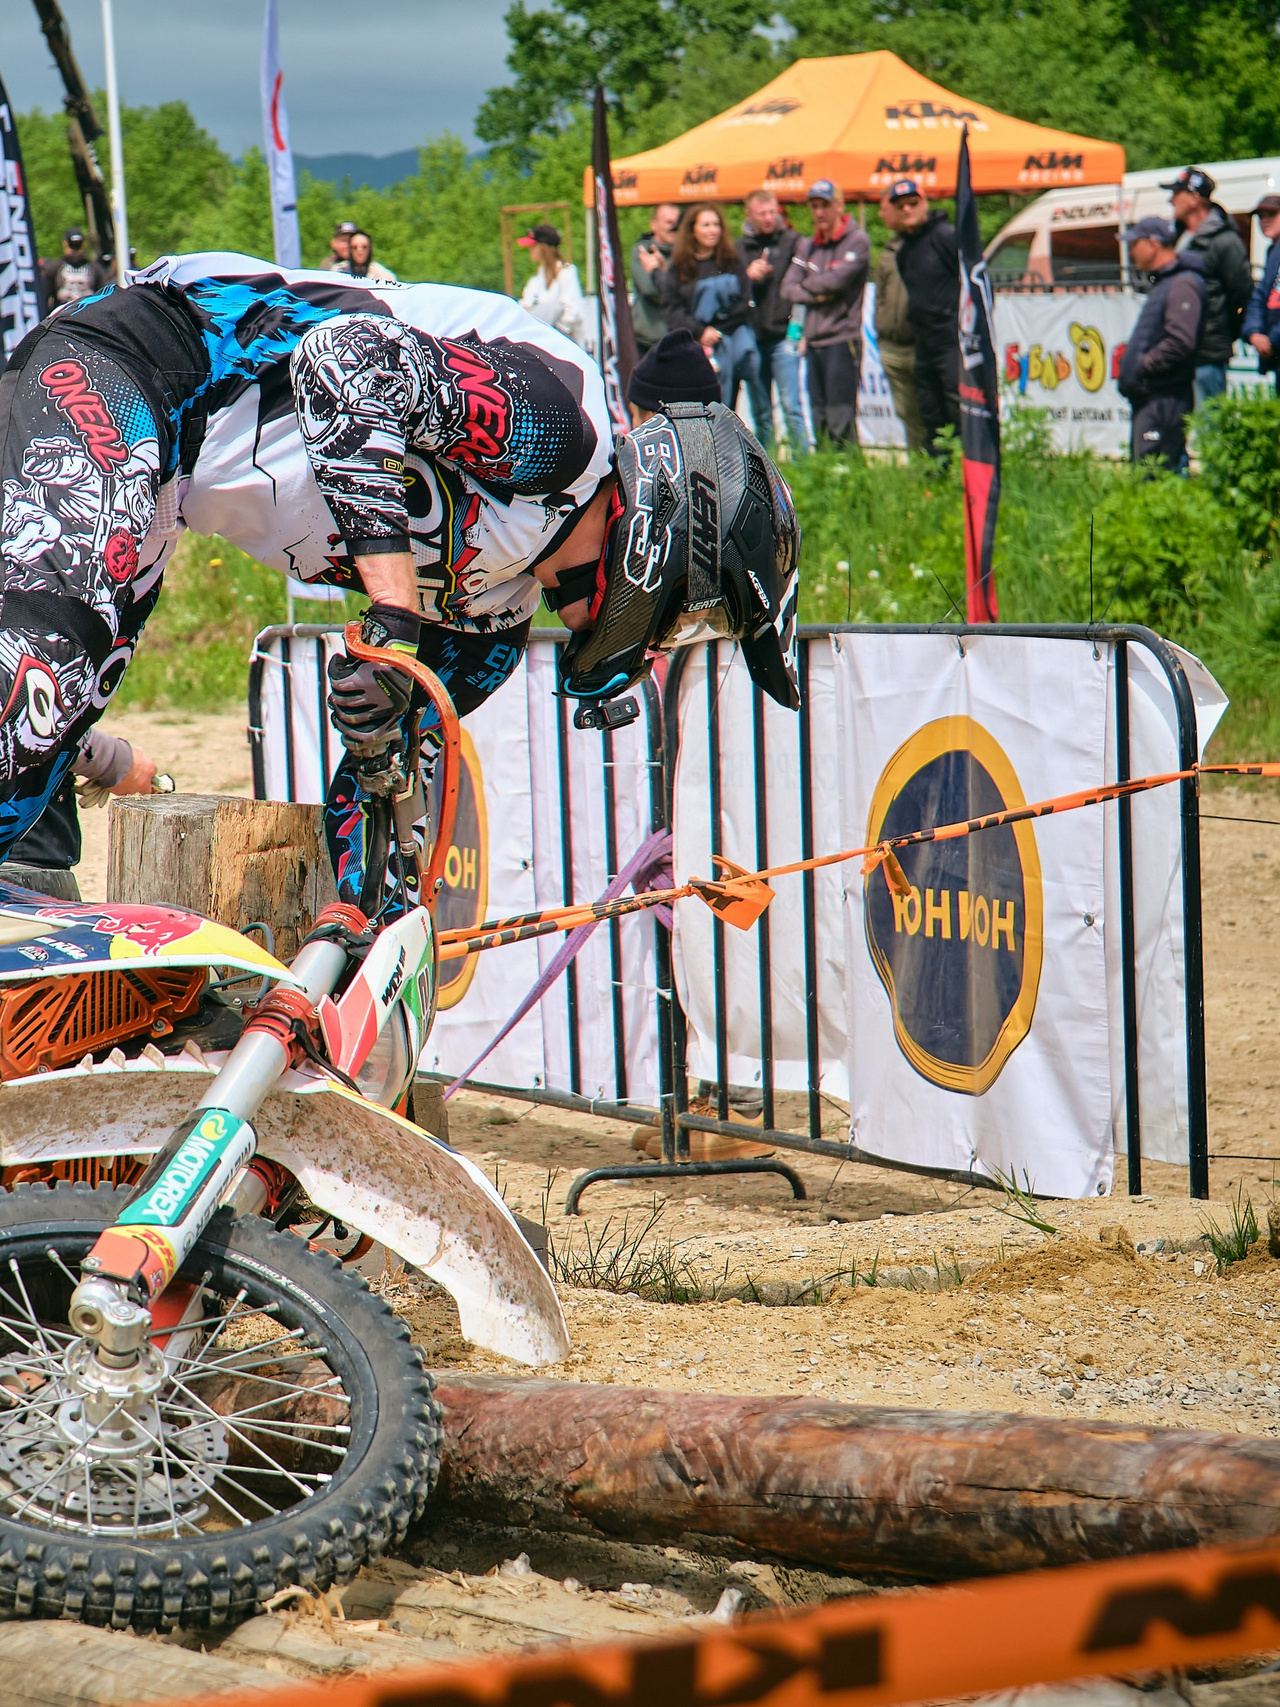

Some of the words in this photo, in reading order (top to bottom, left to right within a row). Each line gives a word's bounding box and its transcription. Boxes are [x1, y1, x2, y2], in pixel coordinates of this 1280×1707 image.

[885, 101, 980, 121] KTM
[875, 154, 937, 173] KTM
[1025, 151, 1084, 170] KTM
[689, 470, 720, 584] LEATT
[687, 598, 723, 612] LEATT
[465, 670, 487, 686] the
[381, 964, 404, 1007] KTM
[141, 1135, 216, 1225] MOTOREX
